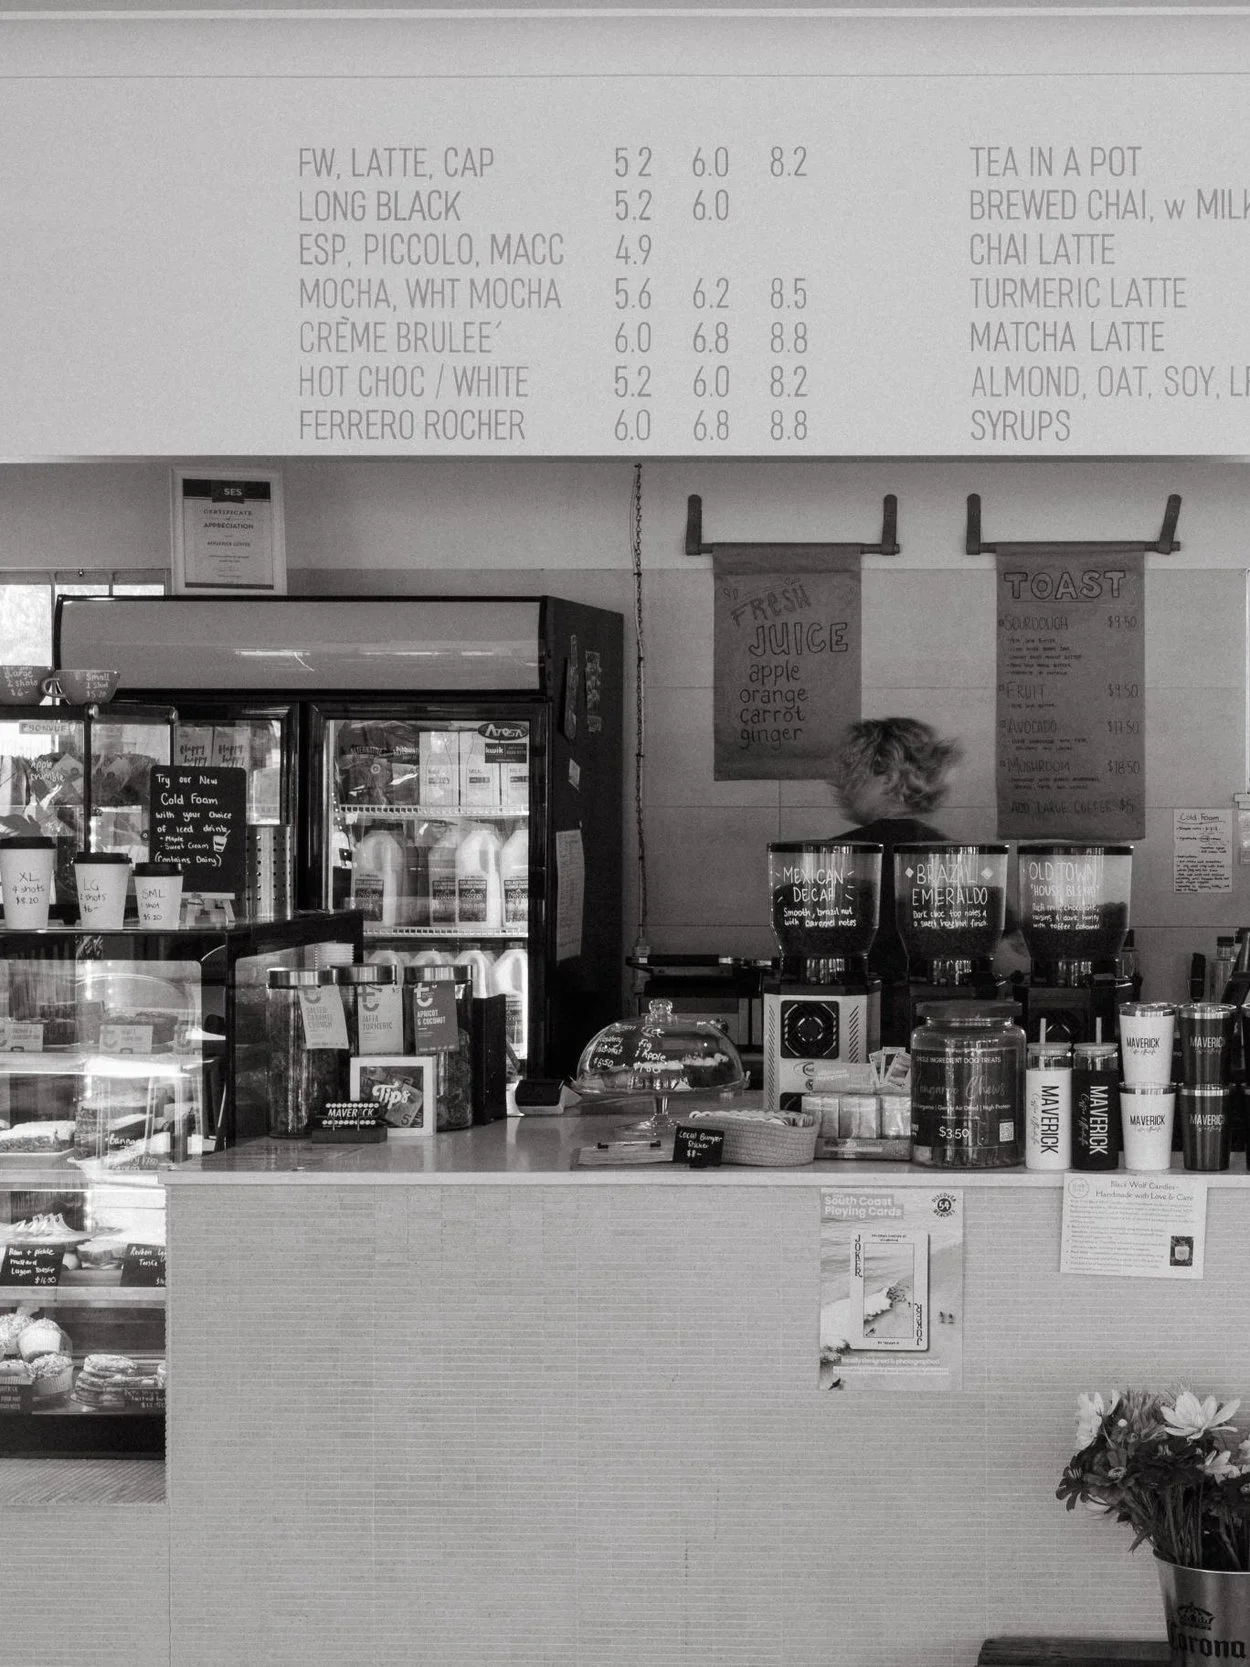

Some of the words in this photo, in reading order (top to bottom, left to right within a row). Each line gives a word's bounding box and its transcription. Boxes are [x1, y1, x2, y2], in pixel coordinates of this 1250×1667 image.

[298, 147, 341, 180] FW,
[351, 146, 434, 180] LATTE,
[443, 146, 495, 178] CAP
[969, 146, 1019, 178] TEA
[1029, 146, 1054, 177] IN
[1063, 146, 1081, 177] A
[1090, 145, 1142, 178] POT
[298, 189, 367, 223] LONG
[376, 189, 462, 222] BLACK
[969, 188, 1077, 221] BREWED
[1087, 188, 1154, 223] CHAI,
[299, 232, 352, 268] ESP,
[364, 232, 480, 268] PICCOLO,
[490, 232, 564, 266] MACC
[969, 232, 1028, 266] CHAI
[1038, 232, 1115, 266] LATTE
[299, 277, 397, 312] MOCHA,
[405, 277, 461, 309] WHT
[469, 277, 562, 310] MOCHA
[970, 276, 1101, 309] TURMERIC
[1110, 276, 1187, 309] LATTE
[299, 315, 387, 354] CRÈME
[969, 320, 1077, 353] MATCHA
[1090, 320, 1165, 353] LATTE
[299, 364, 349, 398] HOT
[358, 364, 425, 398] CHOC
[452, 365, 529, 398] WHITE
[299, 408, 415, 441] FERRERO
[423, 408, 526, 441] ROCHER
[970, 408, 1071, 442] SYRUPS
[224, 488, 242, 496] SES
[1003, 569, 1126, 600] TOAST
[749, 622, 848, 656] JUICE
[749, 660, 801, 686] apple
[740, 688, 809, 708] orange
[740, 707, 806, 725] carrot
[740, 728, 804, 750] ginger
[156, 774, 170, 788] Try
[199, 775, 217, 785] New
[161, 793, 184, 805] Cold
[191, 793, 218, 805] Foam
[157, 825, 166, 833] of
[783, 867, 844, 884] MEXICAN
[1029, 862, 1054, 881] OLD
[912, 887, 988, 905] EMERALDO
[1126, 1036, 1160, 1049] MAVERICK
[1040, 1084, 1060, 1154] MAVERICK
[1089, 1085, 1108, 1156] MAVERICK
[1130, 1114, 1166, 1126] MAVERICK
[824, 1197, 856, 1206] South
[859, 1197, 892, 1206] Coast
[824, 1206, 865, 1218] Playing
[868, 1207, 902, 1216] Cards
[1151, 1192, 1167, 1200] Love
[854, 1234, 863, 1278] JOKER
